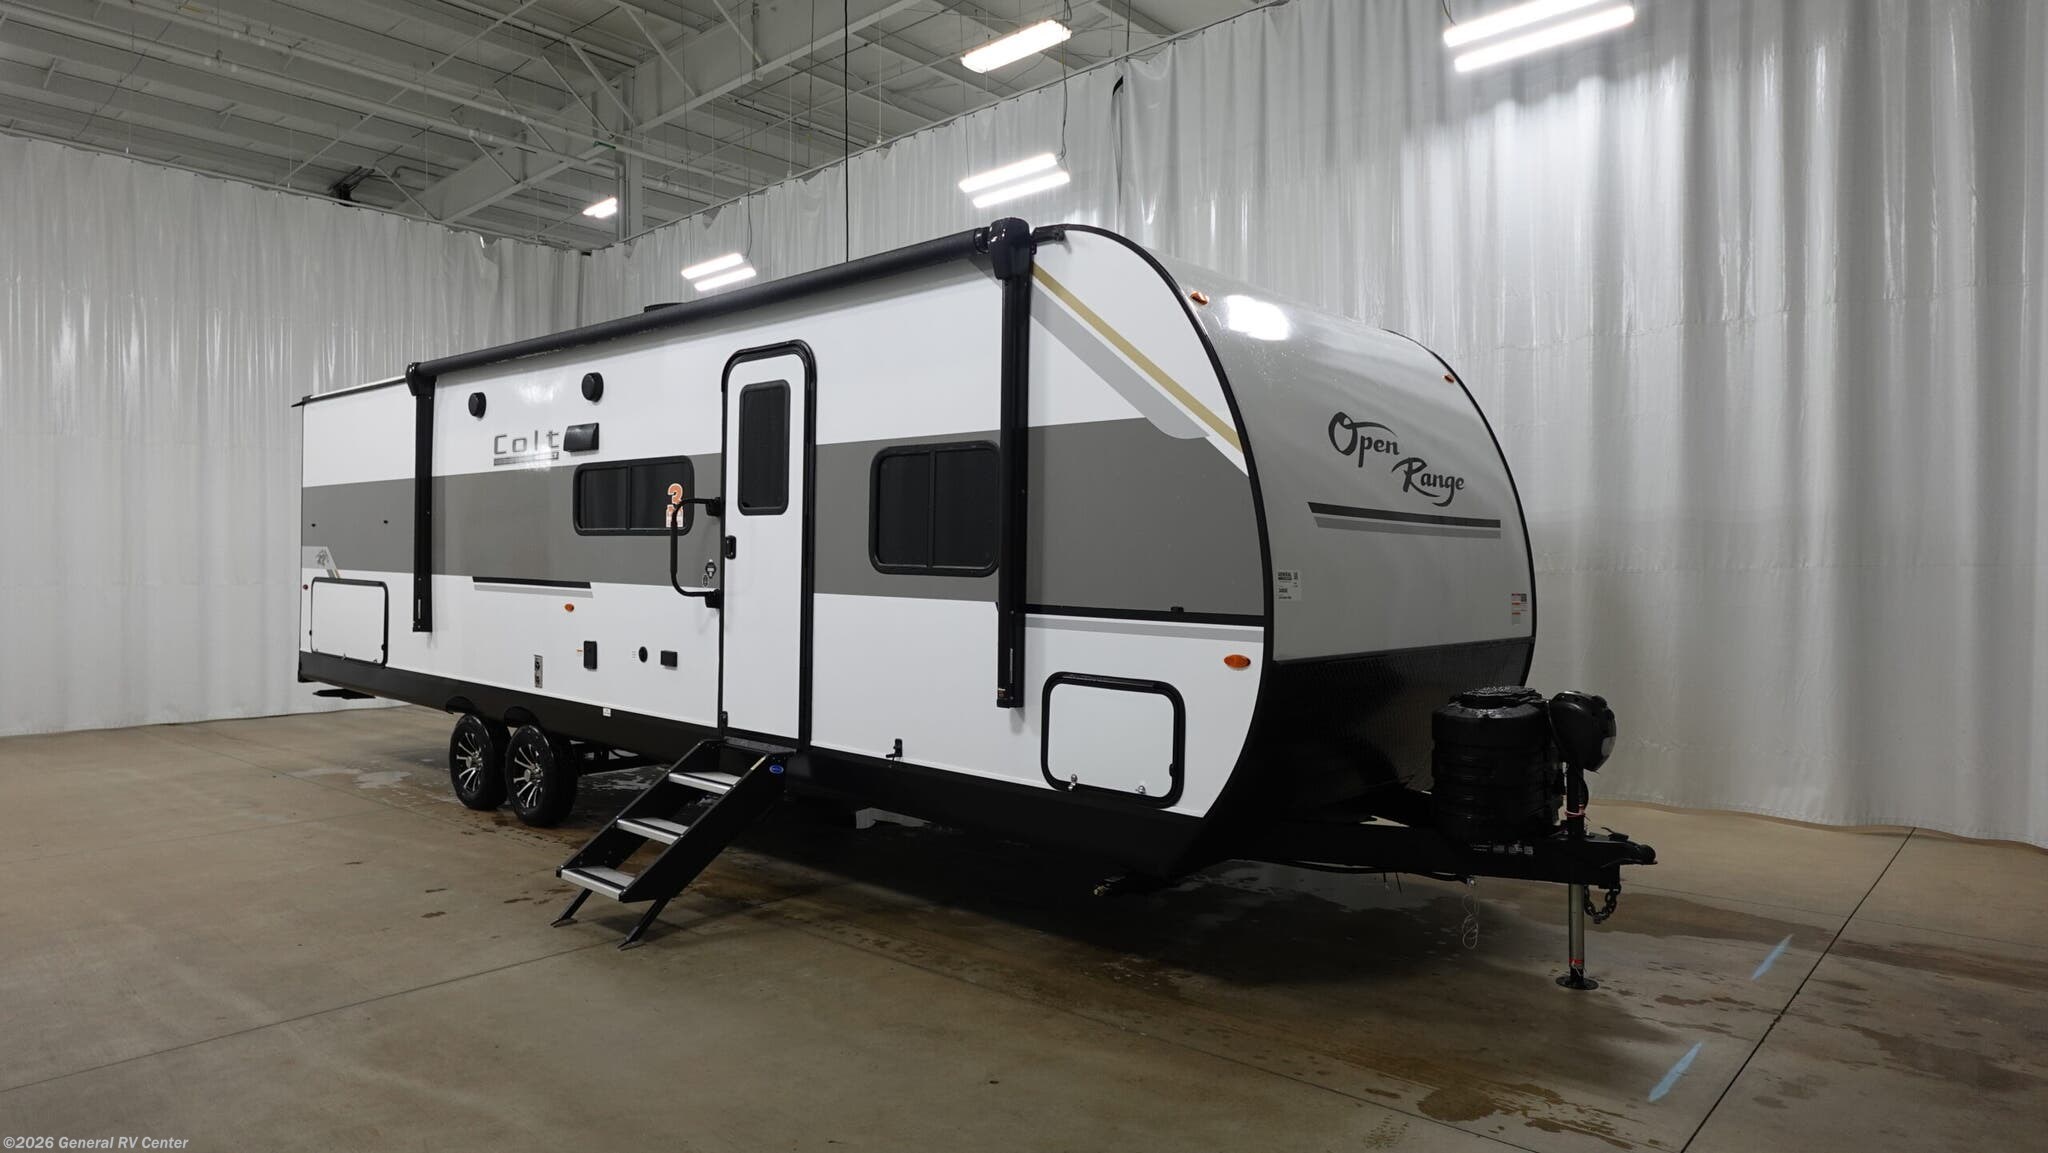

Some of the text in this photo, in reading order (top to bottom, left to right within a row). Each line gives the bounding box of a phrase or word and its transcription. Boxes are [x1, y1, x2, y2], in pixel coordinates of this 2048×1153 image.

[494, 430, 559, 455] Colt
[1328, 412, 1399, 468] Open
[1391, 457, 1465, 507] Range
